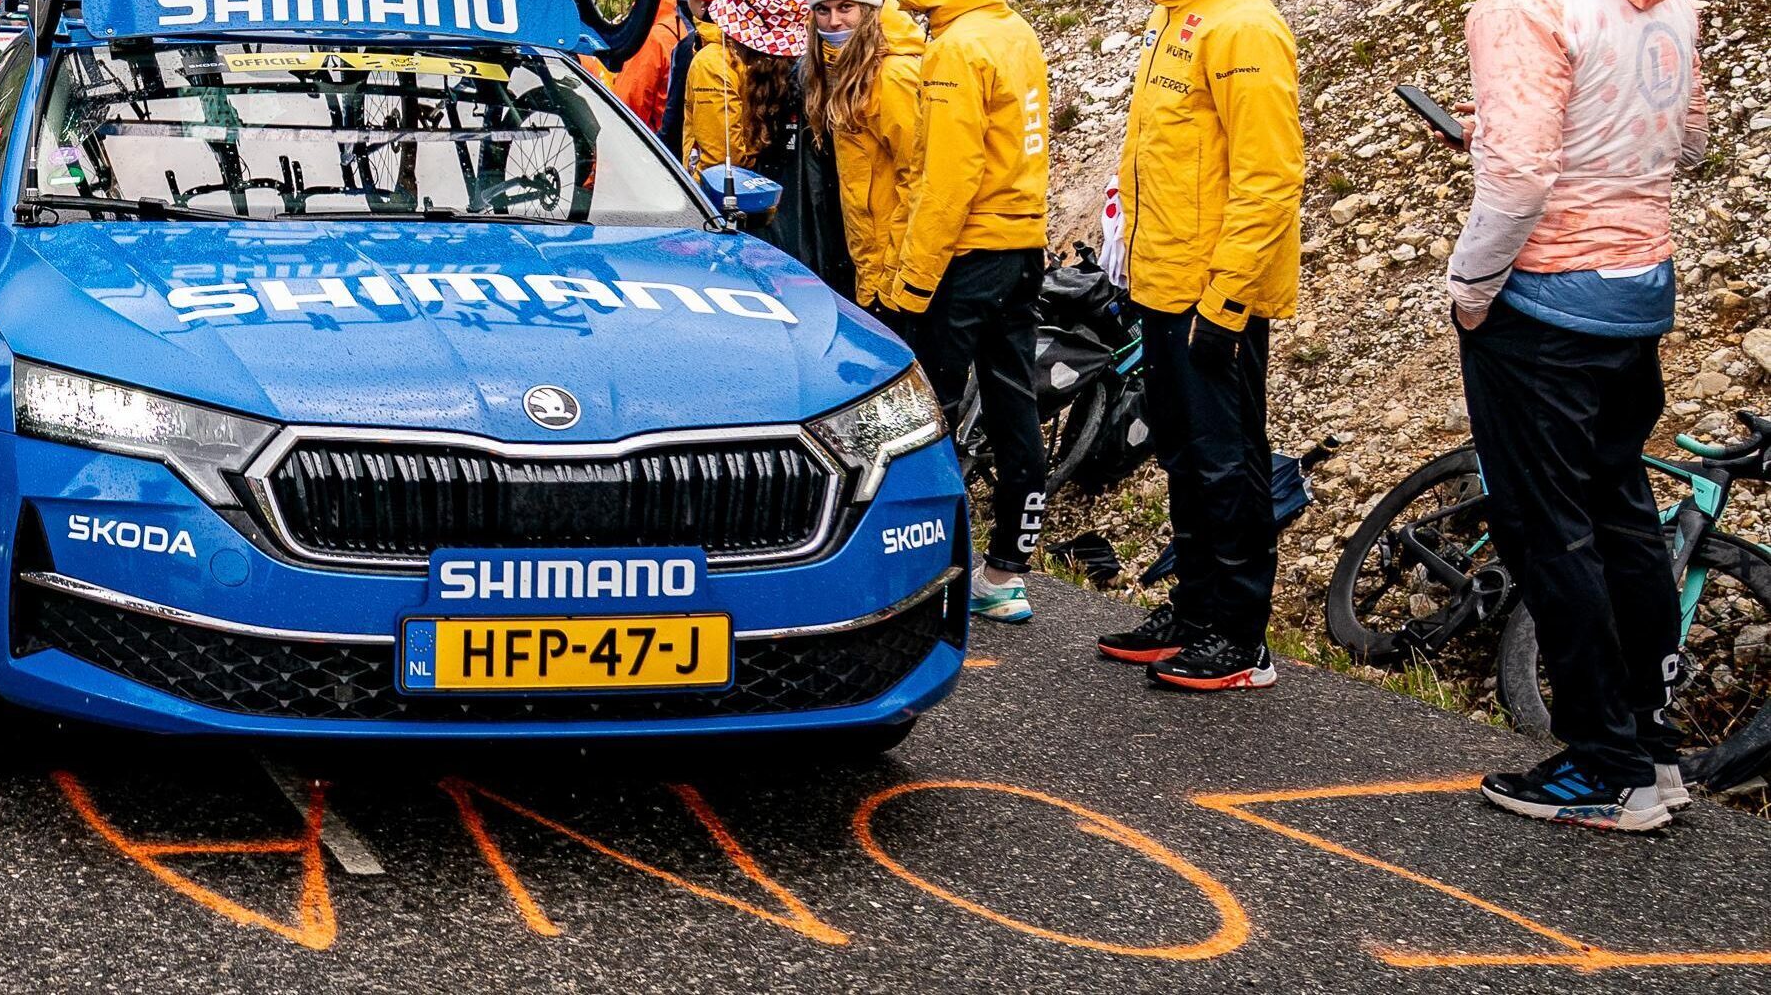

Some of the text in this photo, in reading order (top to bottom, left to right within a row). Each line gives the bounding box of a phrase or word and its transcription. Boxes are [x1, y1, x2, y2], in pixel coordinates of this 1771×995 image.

[232, 57, 482, 77] OFFICIEL 52
[166, 272, 799, 323] SHIMANO
[1017, 491, 1046, 553] GER
[440, 559, 696, 599] SHIMANO
[409, 661, 432, 676] NL
[463, 626, 699, 677] HFP-47-J
